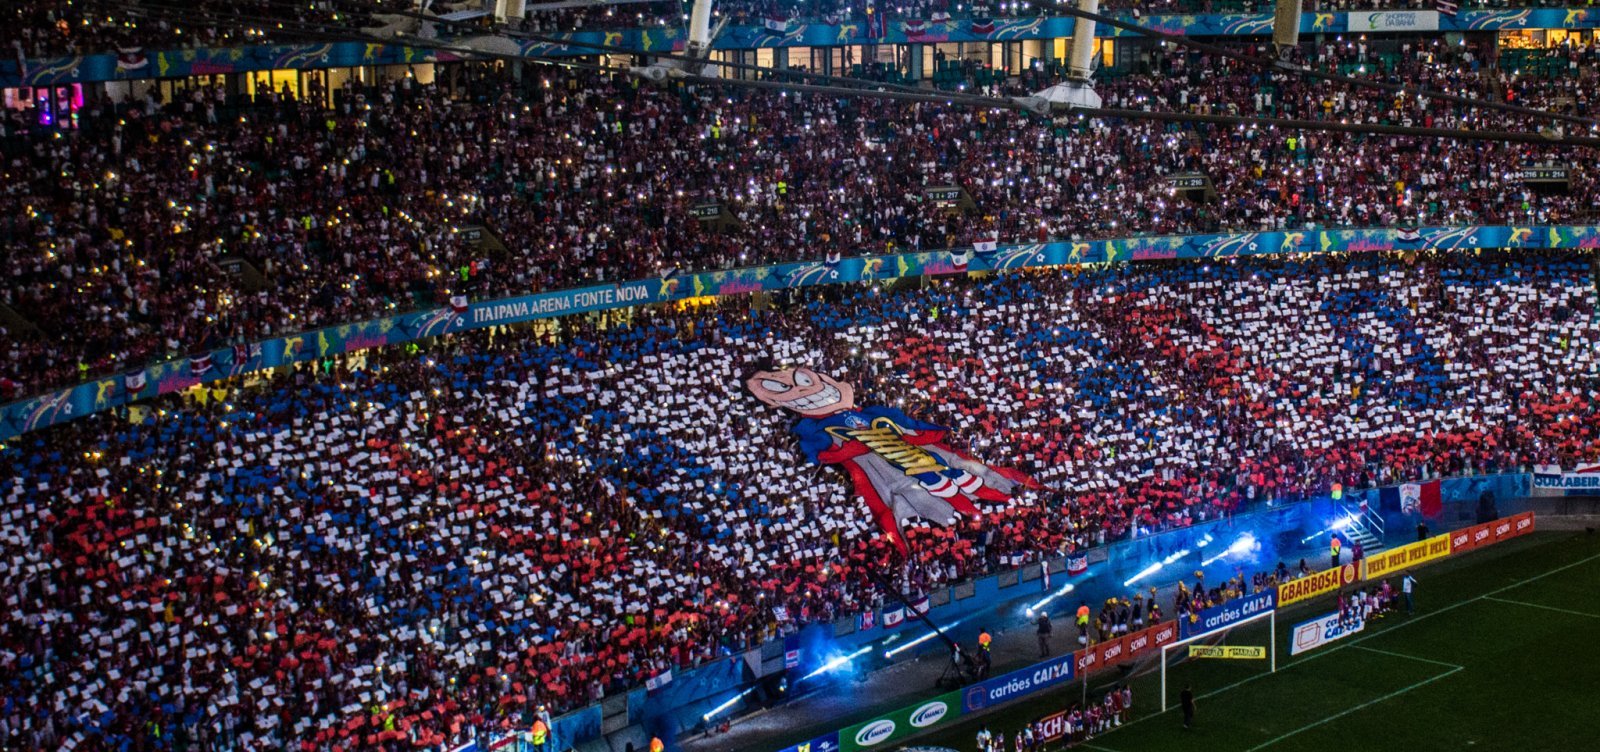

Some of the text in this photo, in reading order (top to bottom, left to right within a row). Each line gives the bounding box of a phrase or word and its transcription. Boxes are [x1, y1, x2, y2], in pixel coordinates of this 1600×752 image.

[947, 191, 959, 199] 217
[474, 285, 649, 323] ITAIPAVA ARENA FONTE NOVA
[1281, 570, 1338, 602] GBARBOSA
[1206, 595, 1273, 628] cartões CAIXA
[1104, 644, 1122, 660] SCHIN
[1130, 635, 1147, 652] SCHIN
[1155, 627, 1173, 644] SCHIN
[990, 661, 1069, 699] cartões CAIXA
[869, 707, 945, 738] AMANCO AMANCO
